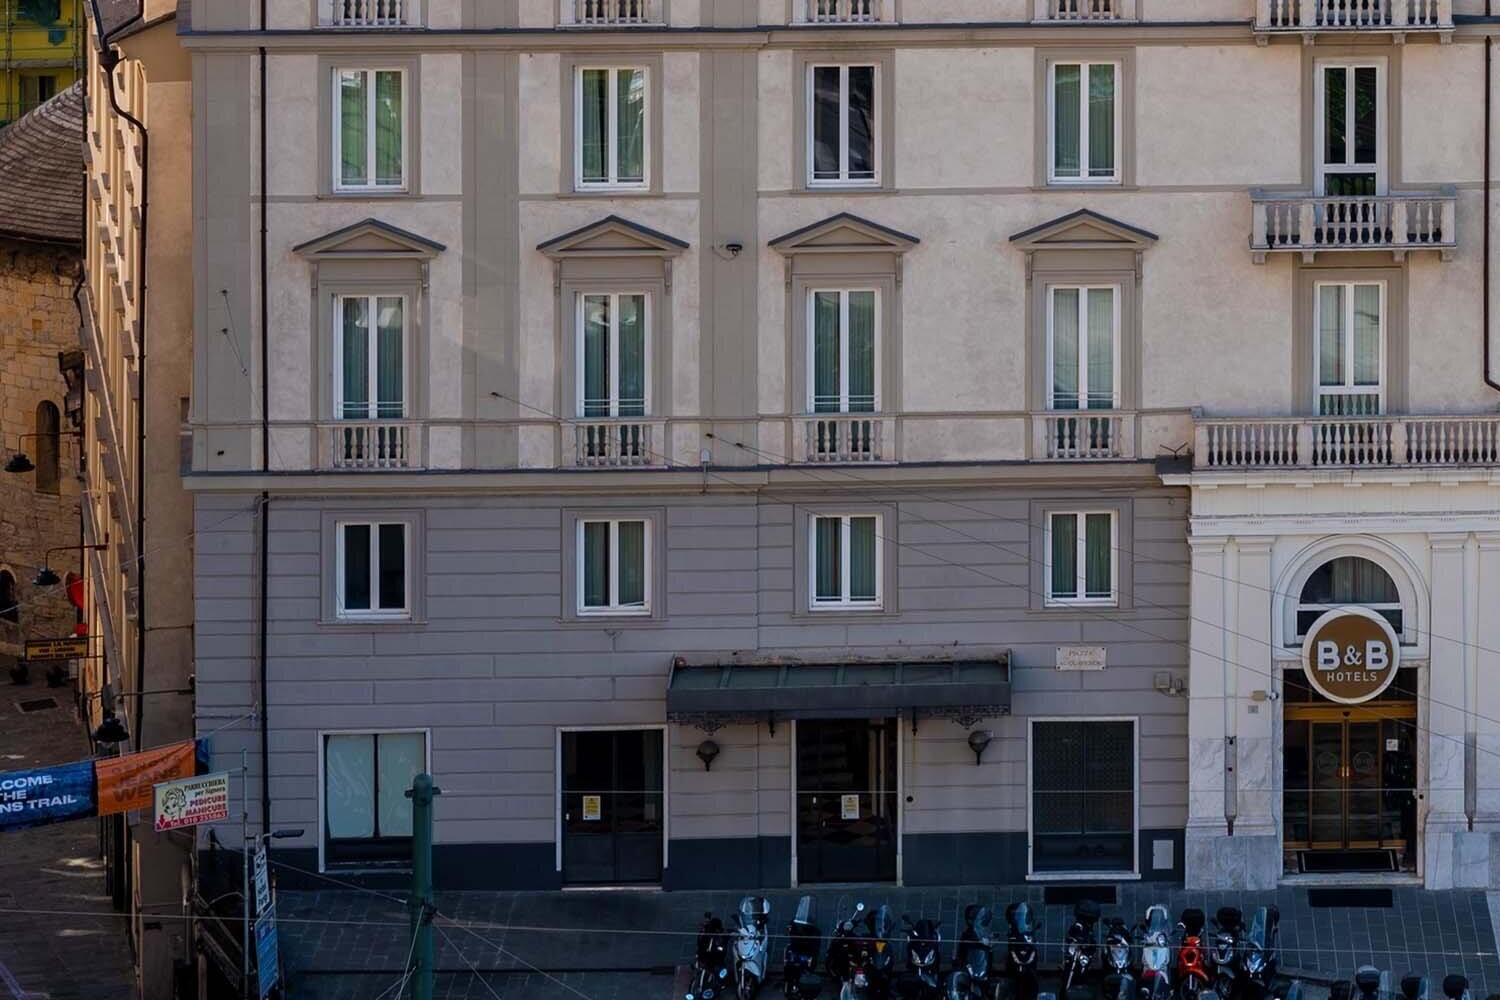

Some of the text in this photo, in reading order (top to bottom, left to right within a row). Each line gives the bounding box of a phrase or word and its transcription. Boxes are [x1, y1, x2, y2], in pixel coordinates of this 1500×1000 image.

[1317, 640, 1389, 671] B&B
[1326, 671, 1378, 683] HOTELS
[0, 775, 53, 791] COME
[26, 794, 78, 809] TRAIL
[112, 785, 152, 803] WE
[189, 795, 226, 807] PEDICURE
[185, 803, 226, 816] MANICURE
